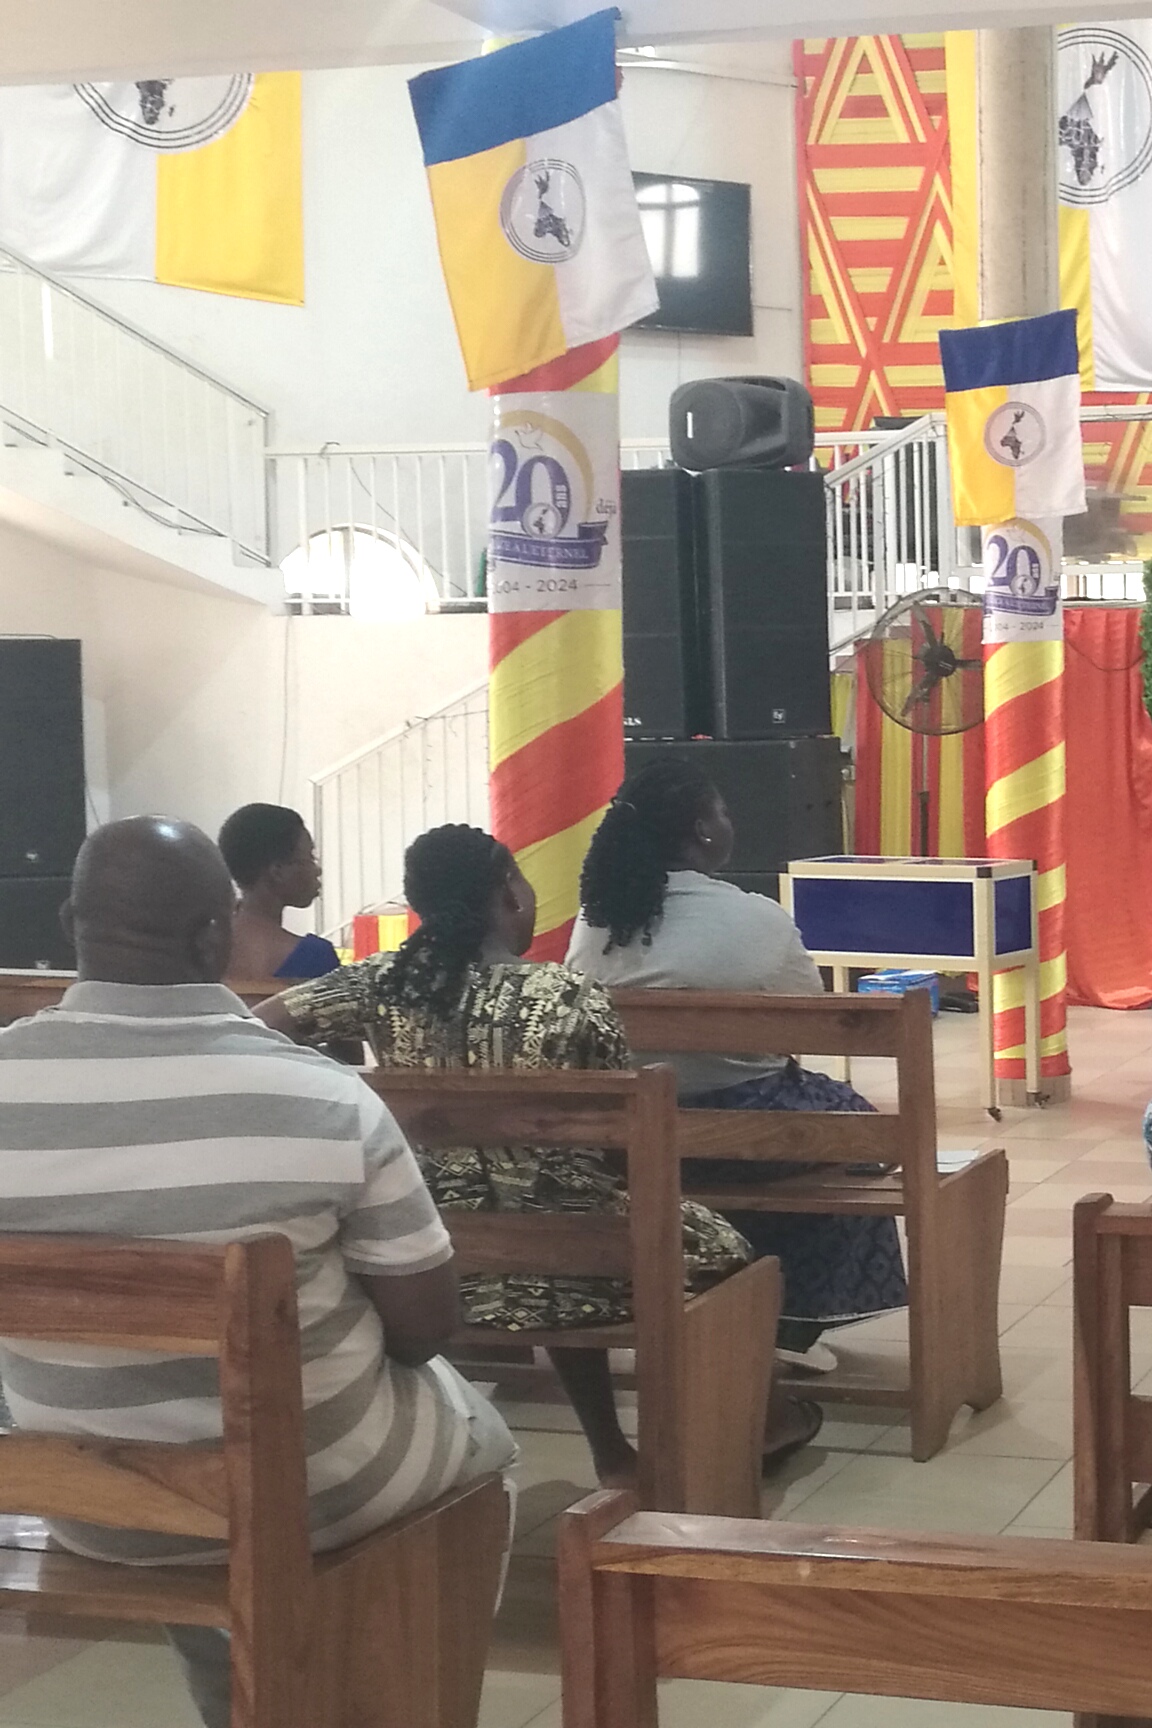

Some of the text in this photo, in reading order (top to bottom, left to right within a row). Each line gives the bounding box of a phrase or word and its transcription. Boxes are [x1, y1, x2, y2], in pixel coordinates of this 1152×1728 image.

[490, 439, 571, 534] 20
[536, 579, 578, 593] 2024
[987, 534, 1041, 592] 20
